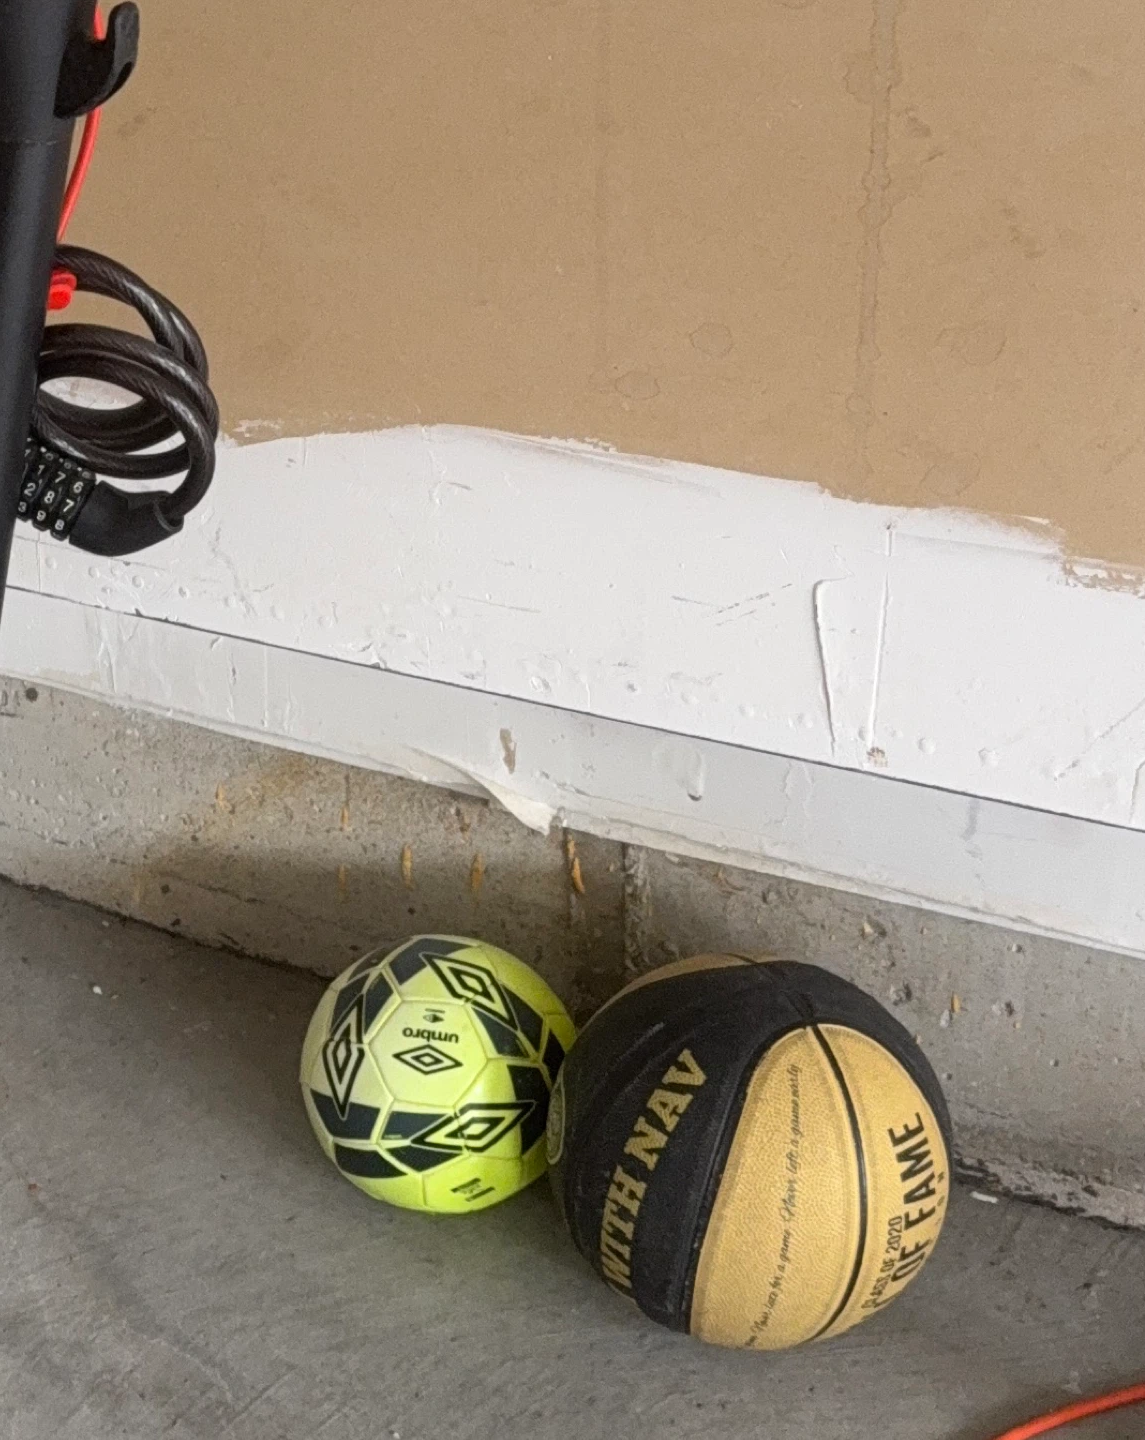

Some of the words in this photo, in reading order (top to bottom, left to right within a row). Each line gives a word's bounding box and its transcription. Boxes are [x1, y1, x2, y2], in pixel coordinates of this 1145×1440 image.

[402, 1026, 459, 1044] umbro
[623, 1047, 707, 1172] NAV
[887, 1112, 937, 1231] FAME
[600, 1164, 648, 1290] WITH
[885, 1215, 903, 1253] 2020
[890, 1237, 932, 1283] OF
